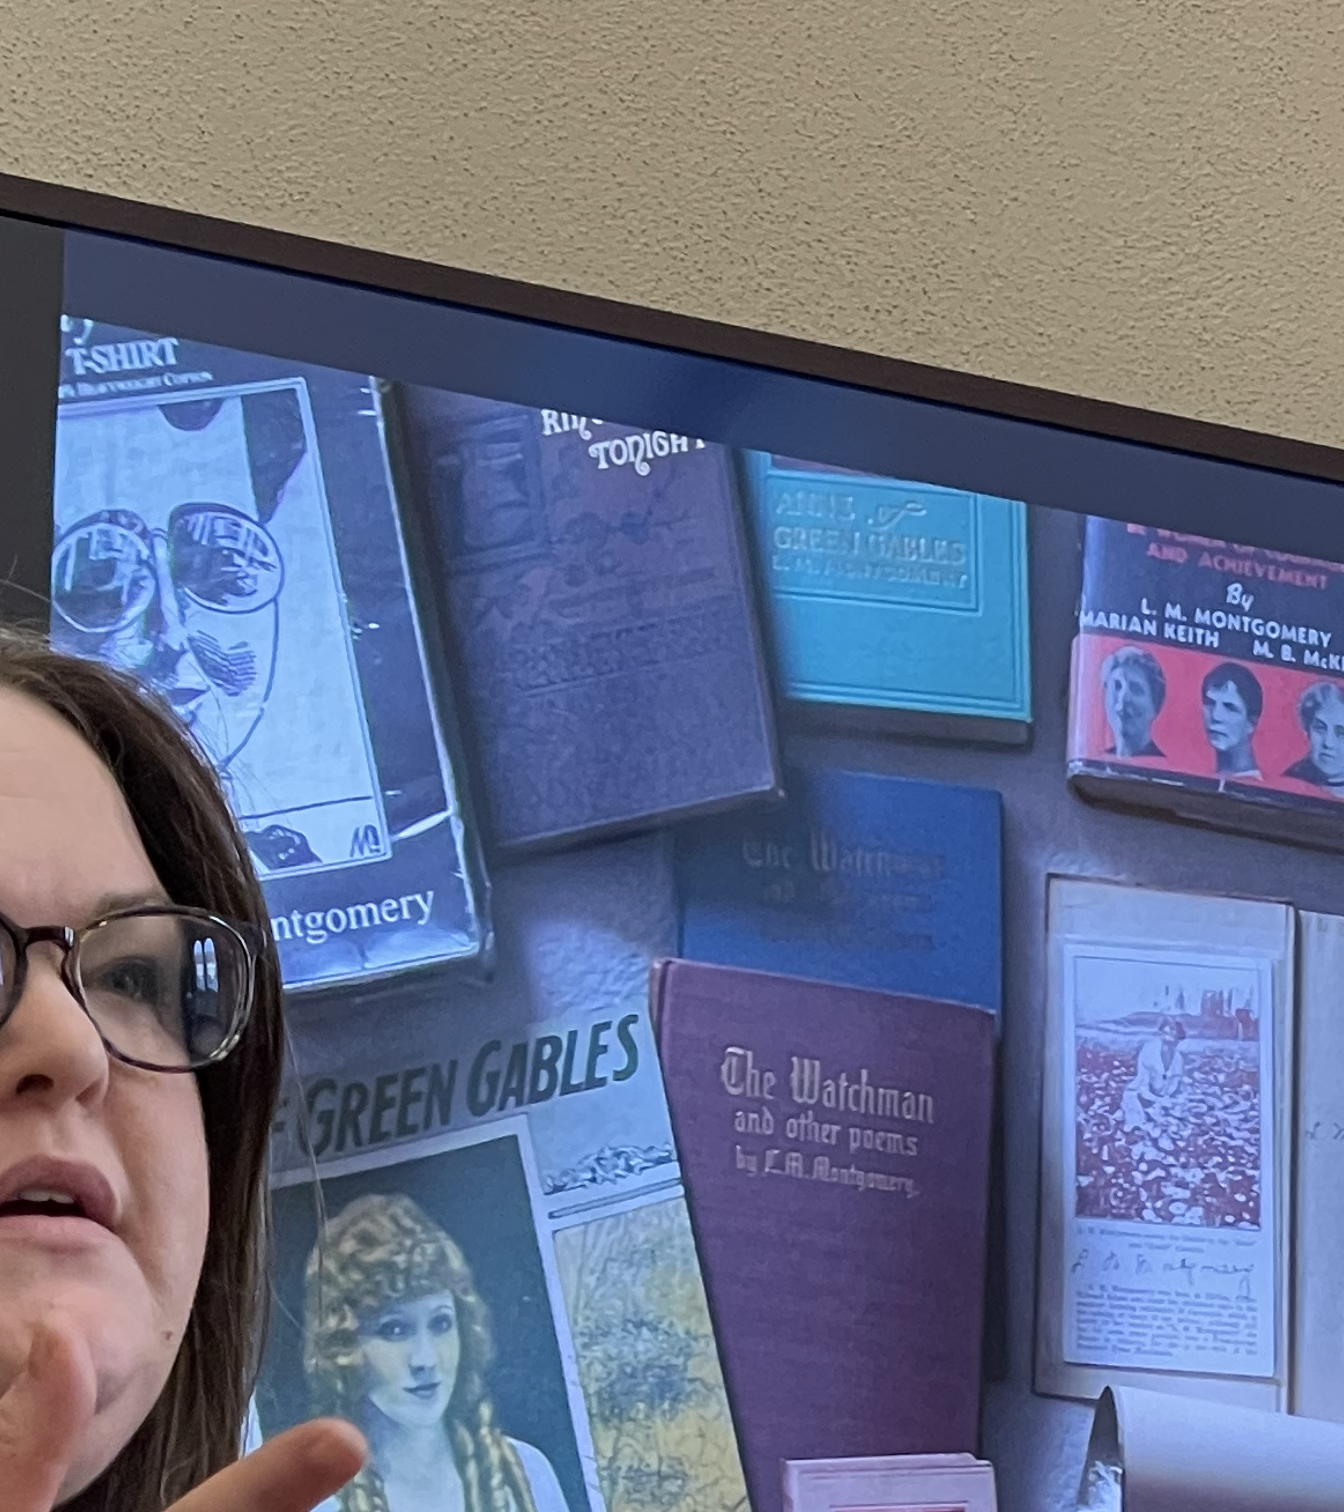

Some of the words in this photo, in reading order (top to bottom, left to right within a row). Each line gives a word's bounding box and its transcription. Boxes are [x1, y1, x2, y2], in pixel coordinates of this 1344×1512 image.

[65, 337, 179, 375] T-SHIRT
[1147, 542, 1188, 563] AND
[1198, 552, 1328, 590] ACHIEVEMENT
[1226, 582, 1255, 612] By
[1079, 610, 1156, 637] MARIAN
[1164, 622, 1220, 648] KEITH
[1141, 598, 1156, 616] L.
[1165, 602, 1187, 622] M.
[1194, 607, 1332, 648] MONTGOMERY
[304, 1059, 458, 1156] GREEN
[466, 1014, 639, 1117] GABLES
[721, 1046, 777, 1100] The
[790, 1056, 934, 1124] Watchman
[734, 1105, 775, 1135] and
[786, 1110, 841, 1145] other
[848, 1126, 918, 1156] poems
[735, 1145, 757, 1177] by
